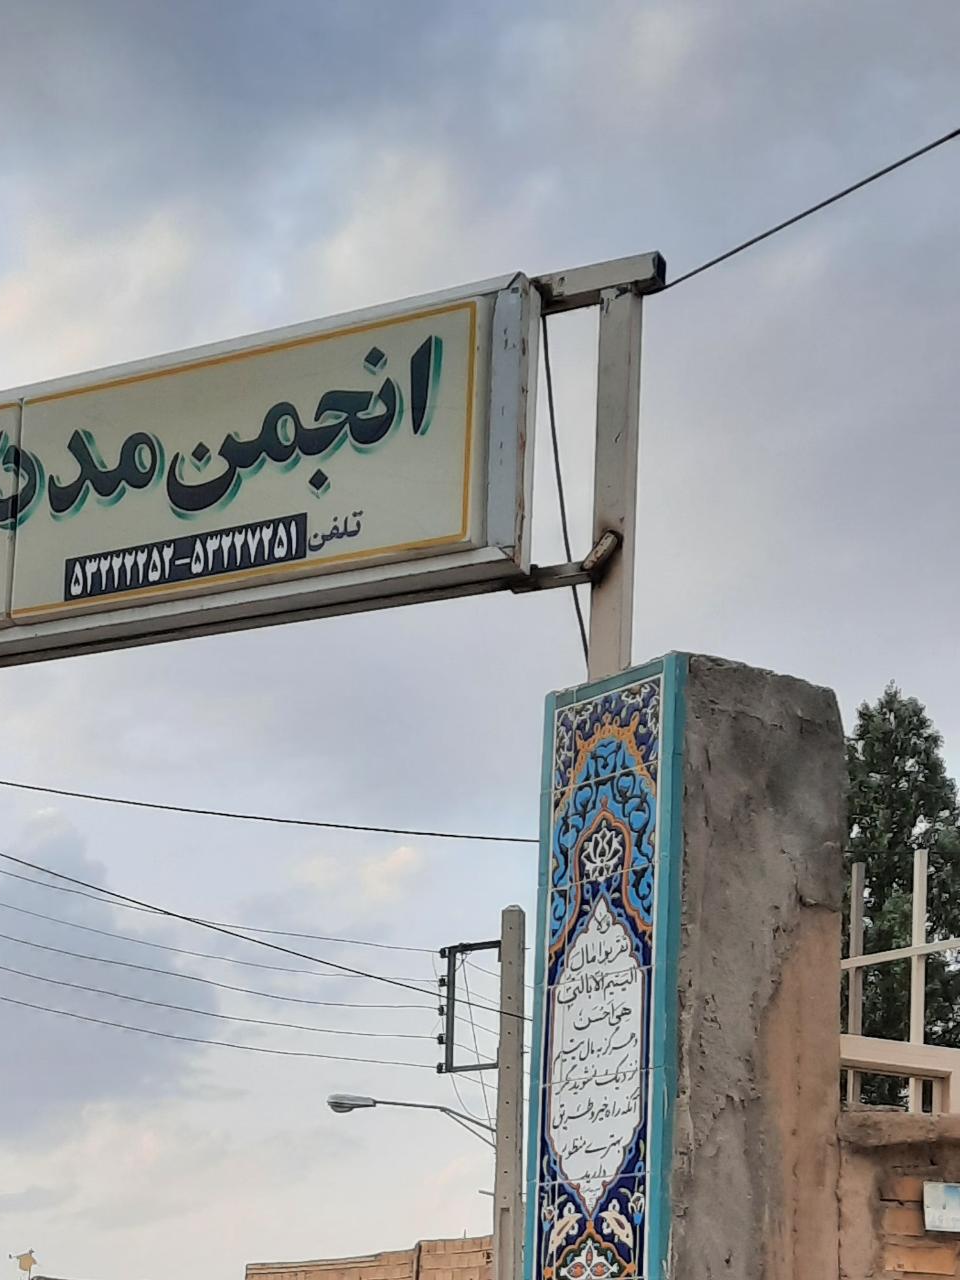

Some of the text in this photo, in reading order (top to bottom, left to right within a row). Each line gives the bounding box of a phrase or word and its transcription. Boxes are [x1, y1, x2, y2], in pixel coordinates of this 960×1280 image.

[167, 335, 443, 521] انجمن
[307, 510, 364, 552] تلفن
[594, 1053, 639, 1090] نزدیک
